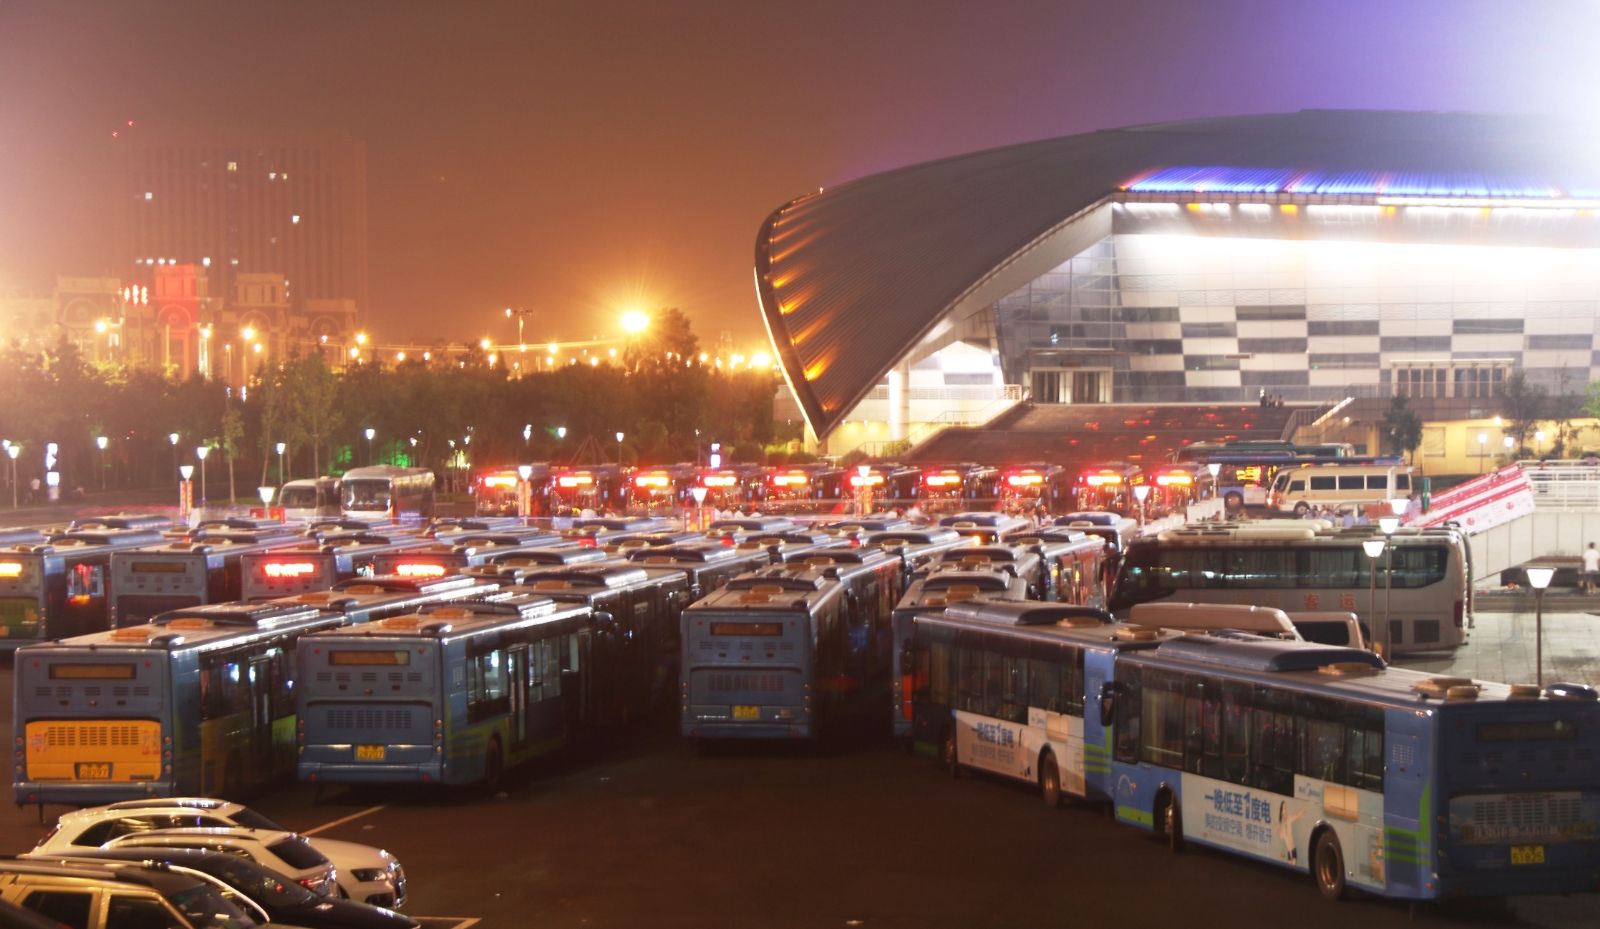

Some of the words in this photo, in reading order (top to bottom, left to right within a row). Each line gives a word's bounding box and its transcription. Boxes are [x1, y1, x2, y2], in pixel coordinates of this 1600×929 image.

[1304, 591, 1356, 610] 客运
[1204, 788, 1272, 824] 一晚低至1度电
